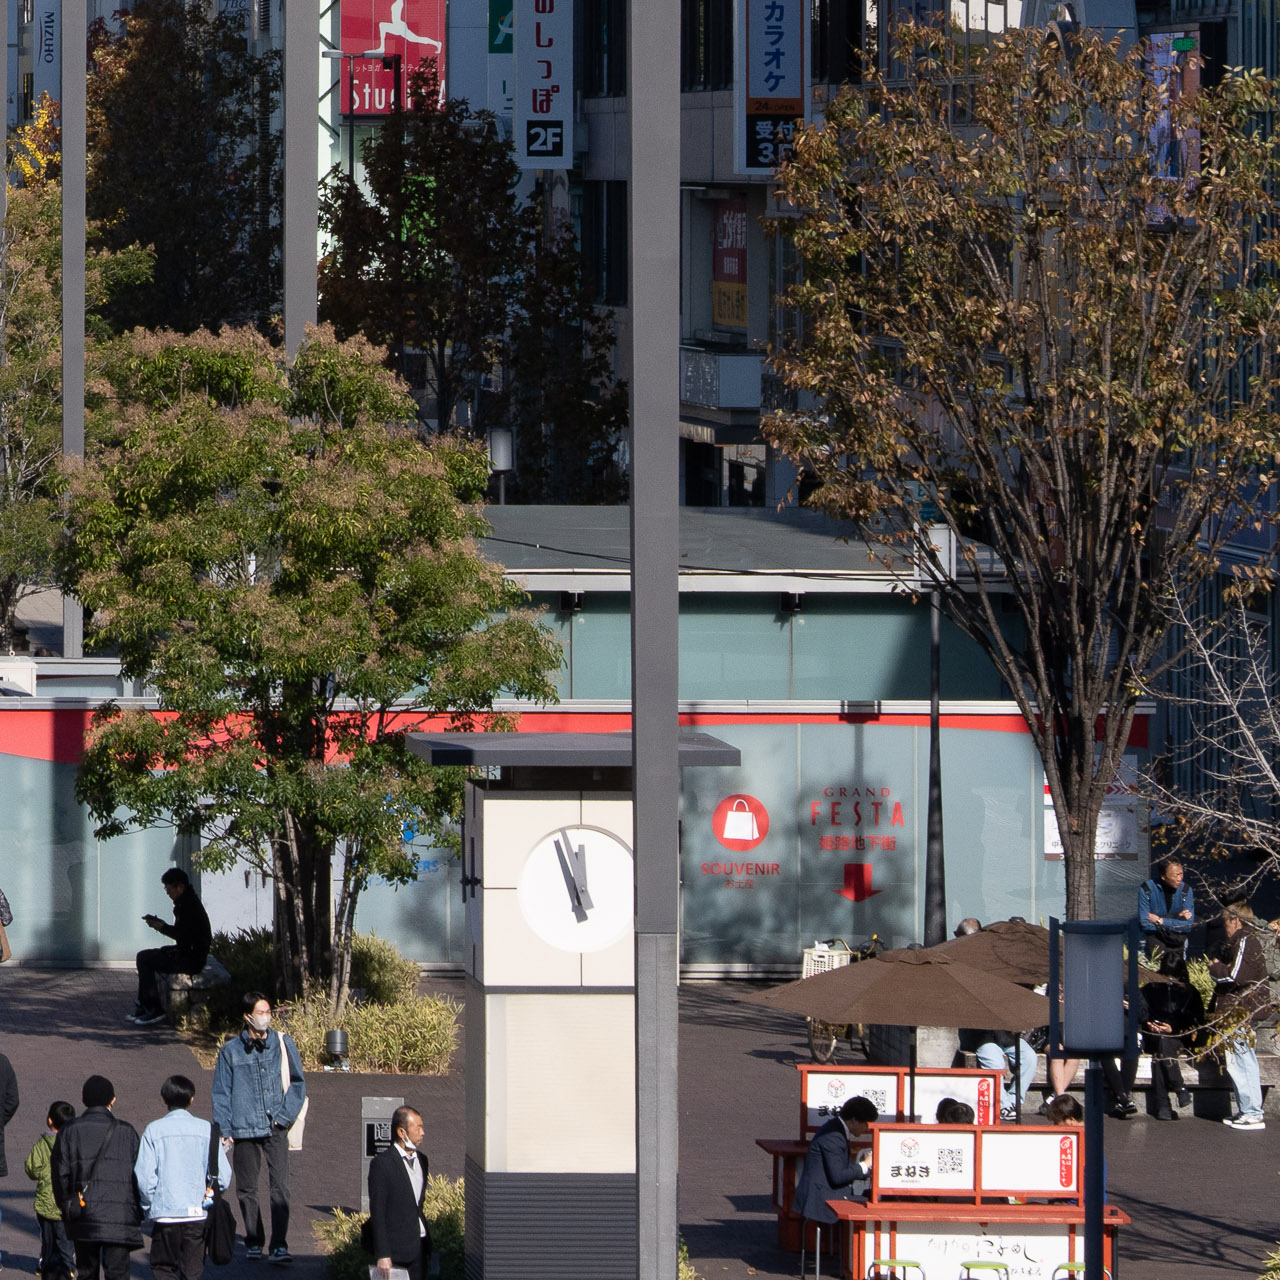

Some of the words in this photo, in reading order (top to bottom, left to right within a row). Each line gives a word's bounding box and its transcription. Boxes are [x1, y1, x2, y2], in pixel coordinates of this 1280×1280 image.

[224, 0, 247, 9] TBC
[42, 11, 55, 64] MIZUHO
[763, 1, 785, 87] カラオケ
[529, 127, 562, 151] 2F
[823, 787, 891, 798] GRAND
[811, 801, 905, 828] FESTA
[819, 836, 897, 851] 姫路地下街
[700, 863, 781, 875] SOUVENIR
[890, 1165, 931, 1178] まねき
